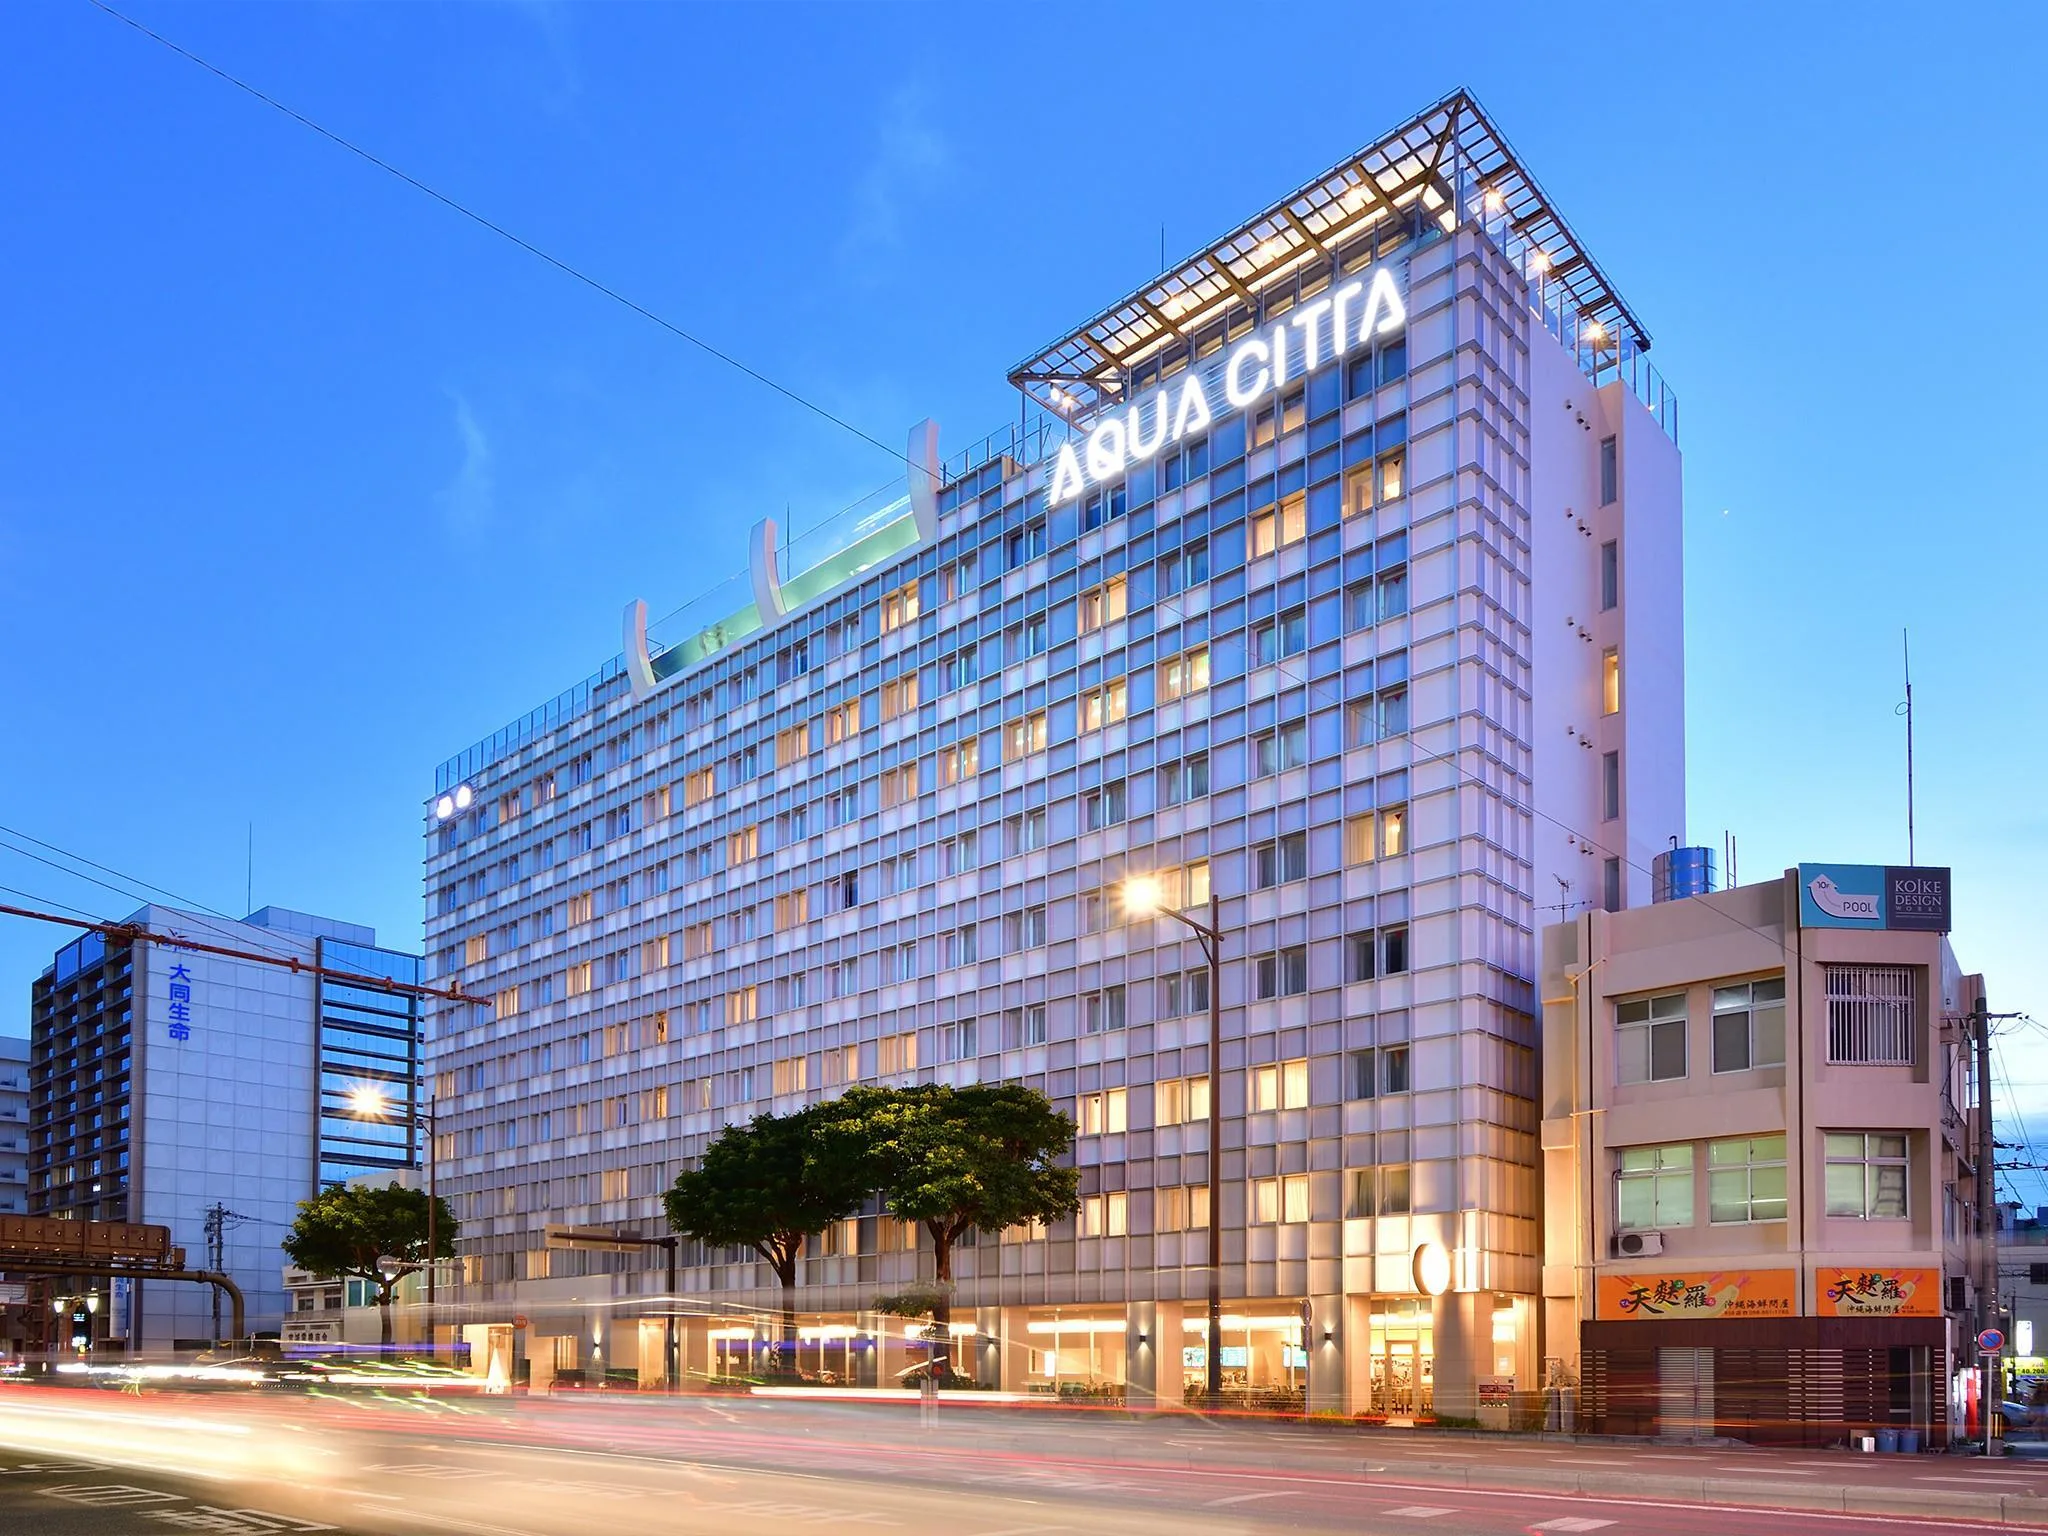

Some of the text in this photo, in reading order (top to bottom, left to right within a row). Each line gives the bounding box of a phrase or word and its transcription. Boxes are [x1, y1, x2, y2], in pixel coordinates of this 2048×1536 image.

[1049, 268, 1407, 506] AQUA CITTA
[1895, 879, 1942, 894] KOIKE
[1843, 901, 1873, 912] POOL
[1895, 895, 1942, 906] DESIGN
[168, 963, 191, 1041] 大同生命
